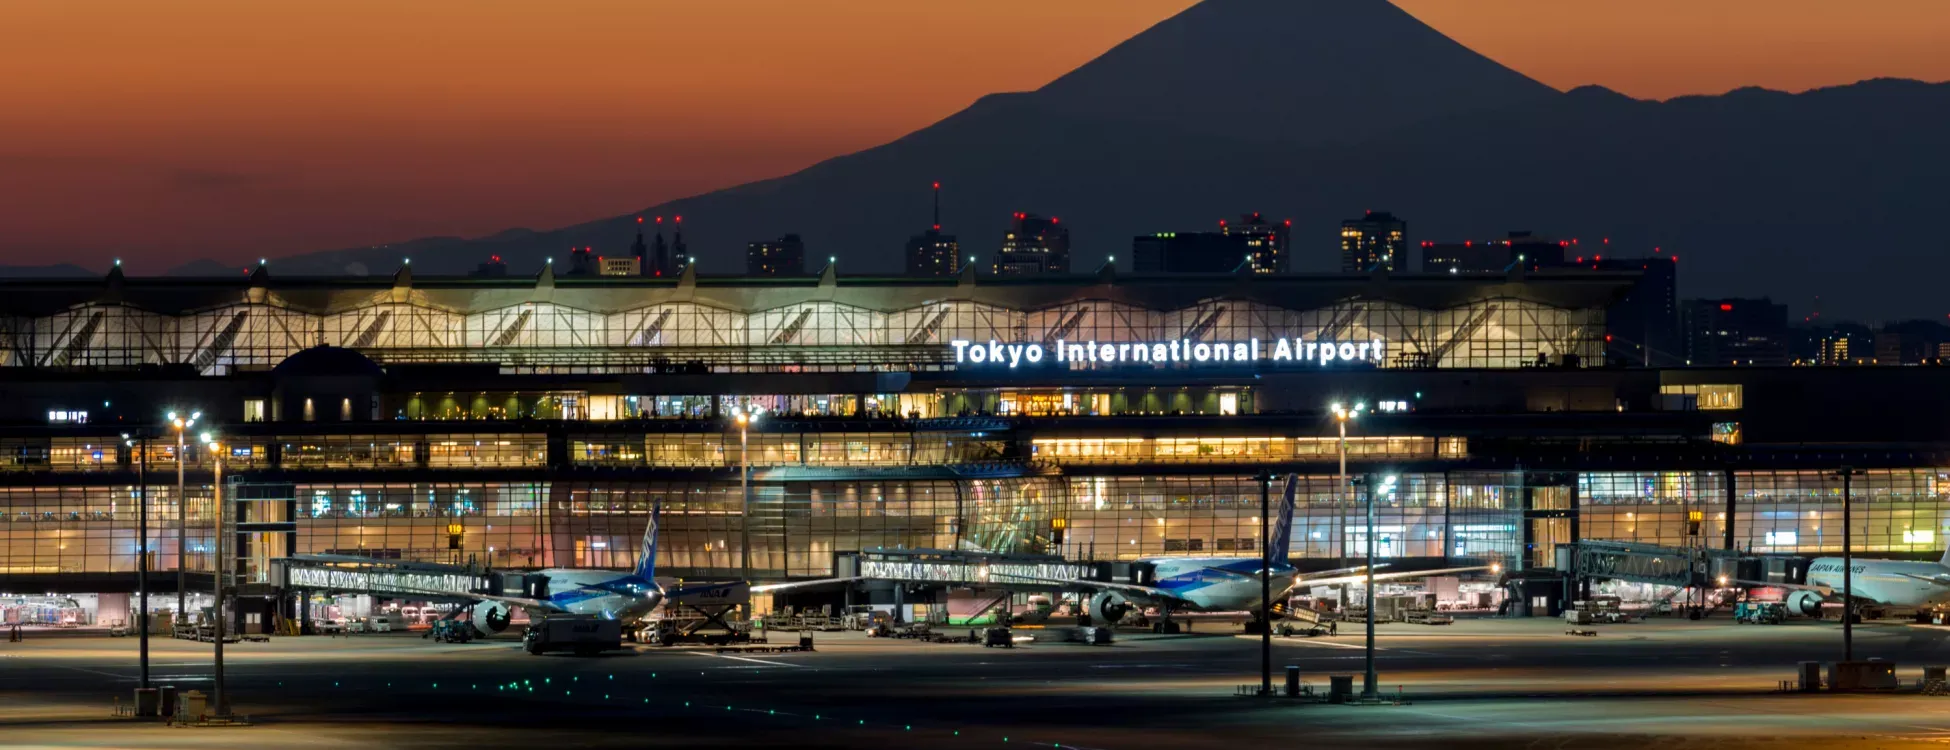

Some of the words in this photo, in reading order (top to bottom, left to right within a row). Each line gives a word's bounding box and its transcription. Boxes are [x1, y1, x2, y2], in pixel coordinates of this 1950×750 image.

[951, 339, 1043, 368] Tokyo
[1057, 338, 1258, 363] International
[1273, 338, 1382, 366] Airport
[448, 525, 461, 533] 110
[639, 518, 656, 570] ANA
[1811, 564, 1835, 572] JAPAN
[1833, 565, 1866, 573] AIRNES
[700, 588, 721, 598] ANA
